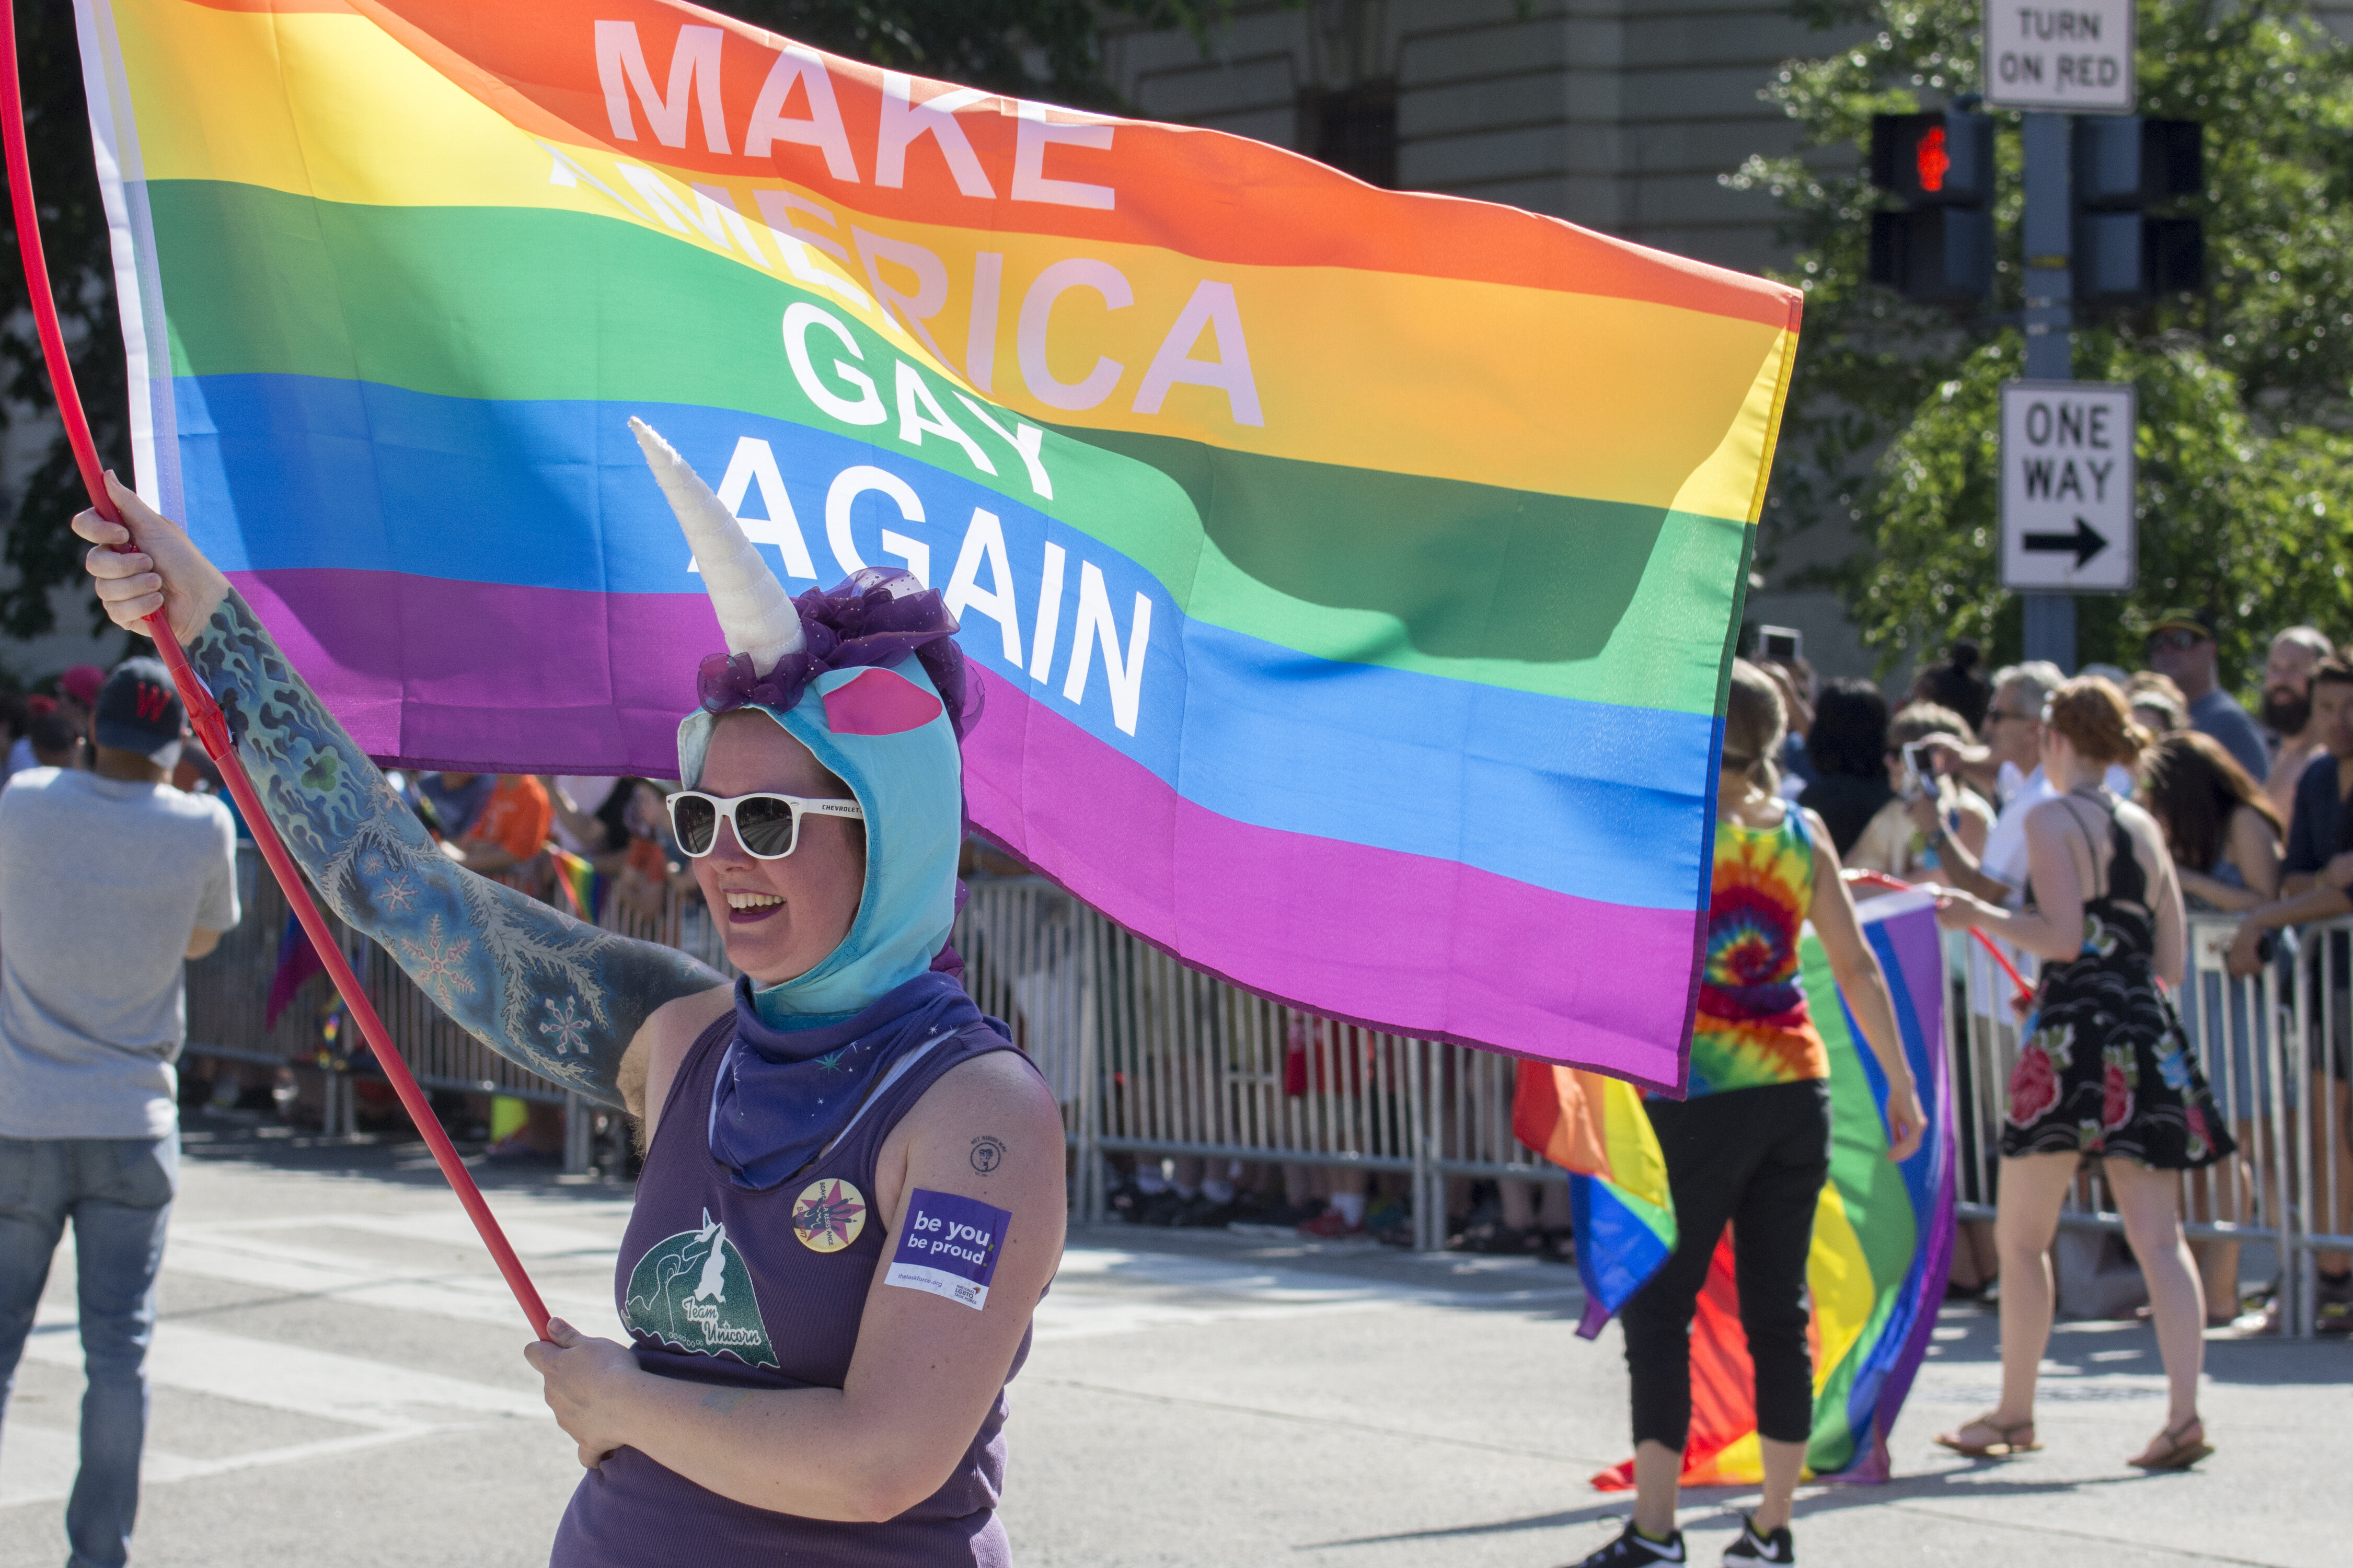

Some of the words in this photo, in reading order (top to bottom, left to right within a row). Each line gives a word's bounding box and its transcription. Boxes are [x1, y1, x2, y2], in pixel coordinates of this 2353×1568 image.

[2018, 8, 2101, 40] TURN
[1999, 51, 2043, 84] ON
[2056, 54, 2119, 87] RED
[594, 19, 1115, 210] MAKE
[533, 138, 1265, 428] AMERICA
[782, 301, 1053, 501] GAY
[2025, 402, 2110, 450] ONE
[2022, 456, 2114, 503] WAY
[687, 436, 1152, 737] AGAIN
[137, 681, 172, 723] W
[822, 805, 860, 813] CHEVROLET
[914, 1210, 942, 1232] be
[944, 1221, 995, 1252] you,
[907, 1233, 928, 1249] be
[930, 1240, 987, 1267] proud.
[898, 1273, 942, 1288] thetaskforce.org
[955, 1287, 974, 1299] LGBTQ
[956, 1284, 975, 1294] NATIONAL
[682, 1297, 718, 1320] Team
[964, 1296, 977, 1305] FORCE
[703, 1318, 761, 1344] Unicorn
